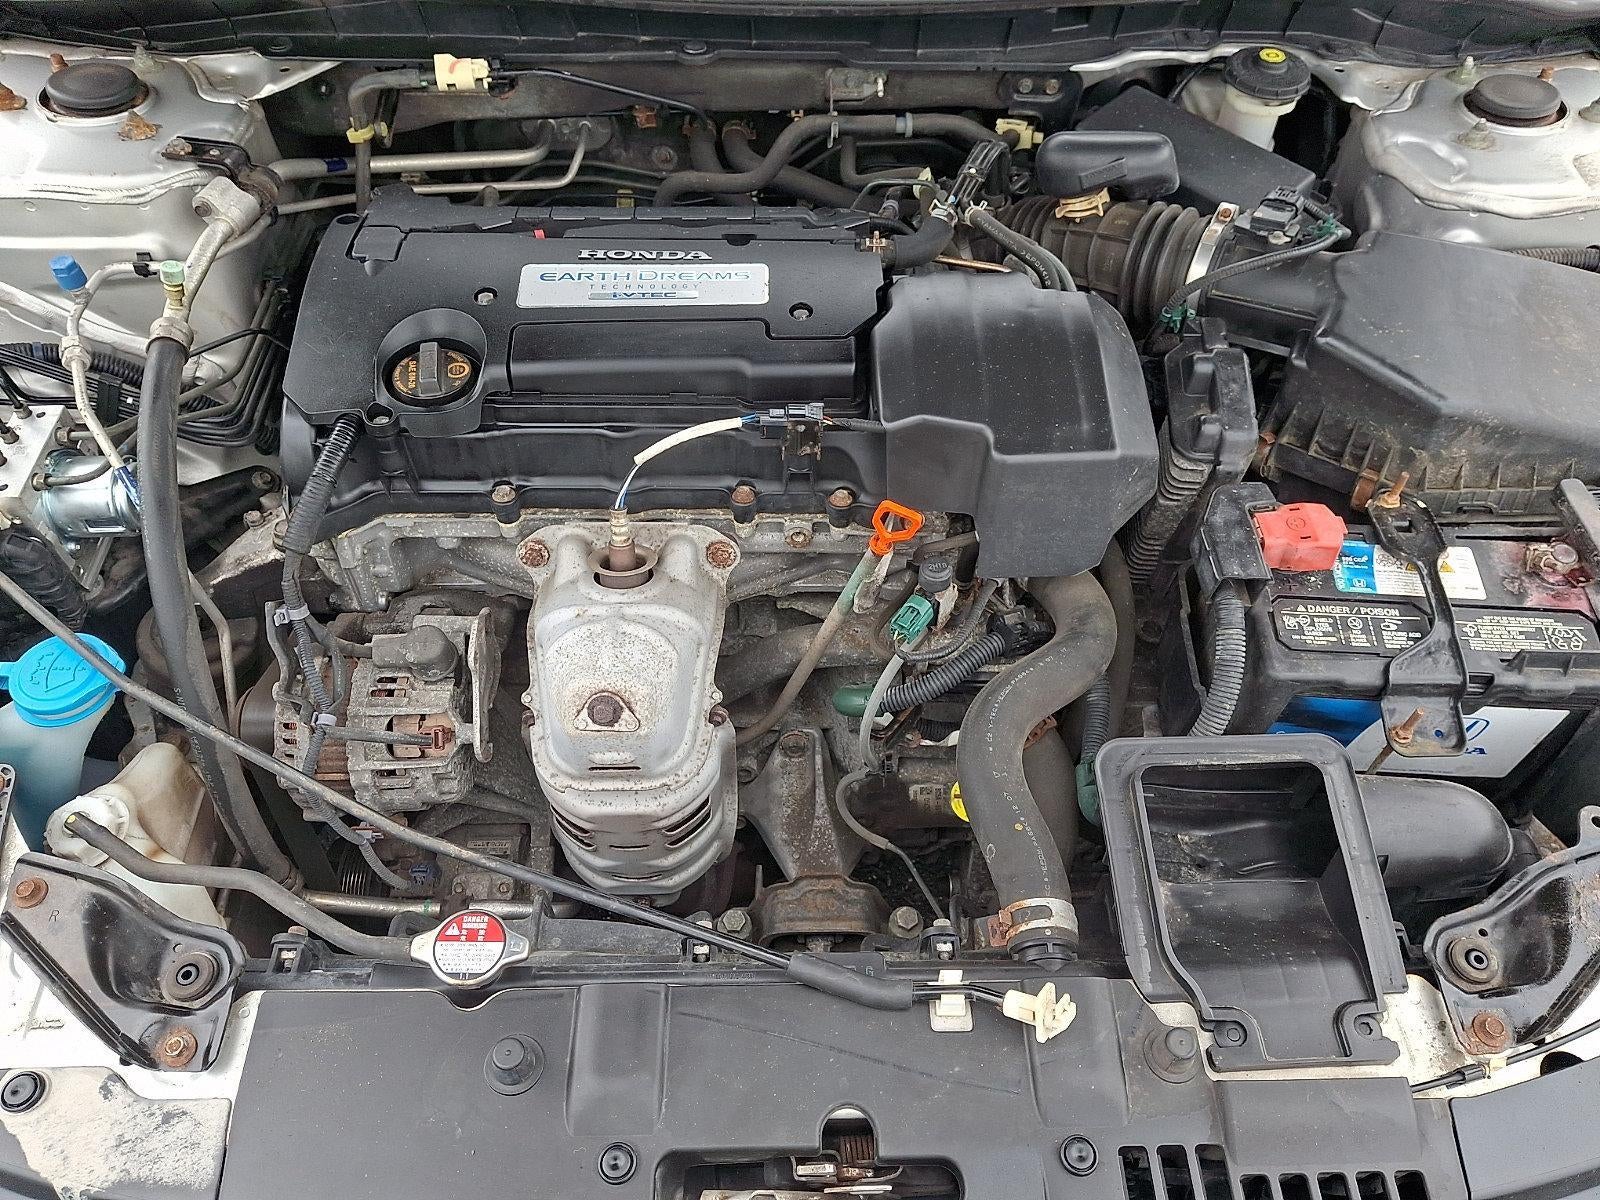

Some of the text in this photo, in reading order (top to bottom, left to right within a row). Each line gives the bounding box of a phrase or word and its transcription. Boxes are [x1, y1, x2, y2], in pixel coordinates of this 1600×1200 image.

[577, 248, 712, 261] HONDA
[540, 270, 750, 282] EARTH DREAMS
[1307, 604, 1350, 614] DANGER
[1360, 607, 1400, 617] POISON
[49, 909, 60, 922] R
